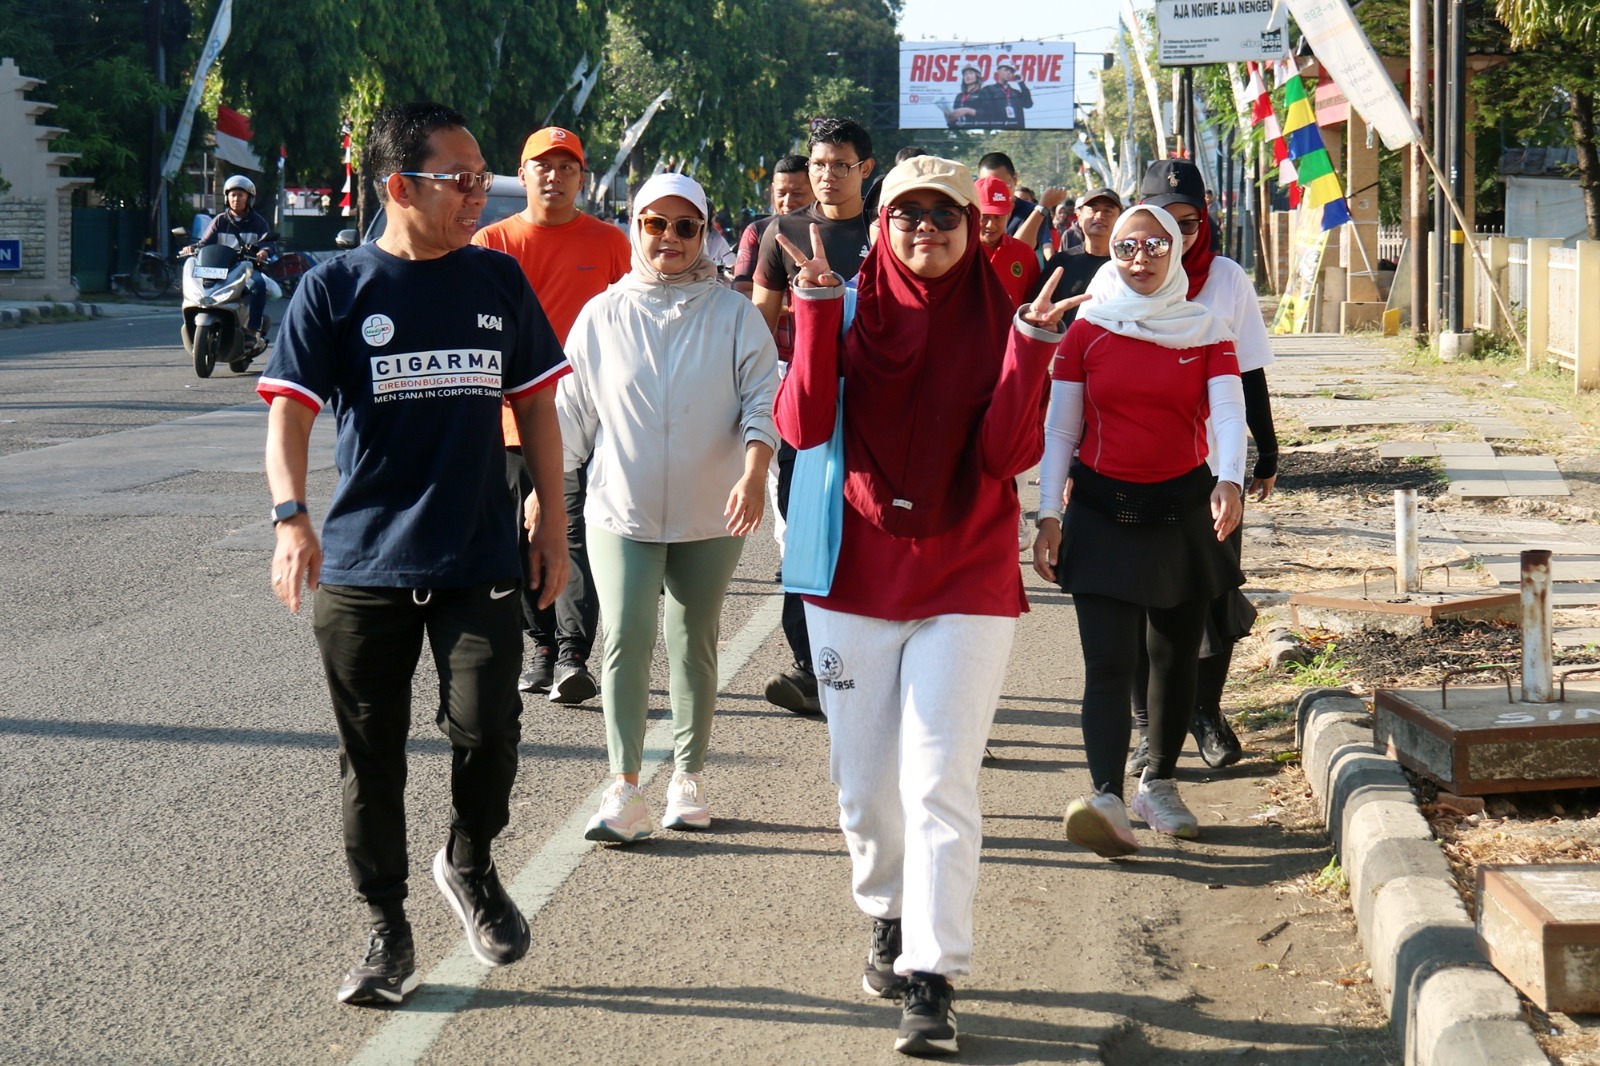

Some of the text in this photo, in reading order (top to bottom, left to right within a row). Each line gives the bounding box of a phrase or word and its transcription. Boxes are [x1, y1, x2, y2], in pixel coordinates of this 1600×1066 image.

[1174, 4, 1190, 19] AJA
[1191, 2, 1218, 17] NGIWE
[1220, 1, 1237, 15] AJA
[1240, 39, 1281, 48] cirebon
[909, 54, 961, 82] RISE
[994, 54, 1064, 82] SERVE
[477, 313, 502, 331] KAI
[376, 353, 499, 375] CIGARMA
[378, 376, 500, 391] CIREBON BUGAR BERSAMA
[374, 393, 396, 404] MEN
[398, 391, 423, 400] SANA
[425, 390, 436, 398] IN
[437, 388, 483, 397] CORPORE
